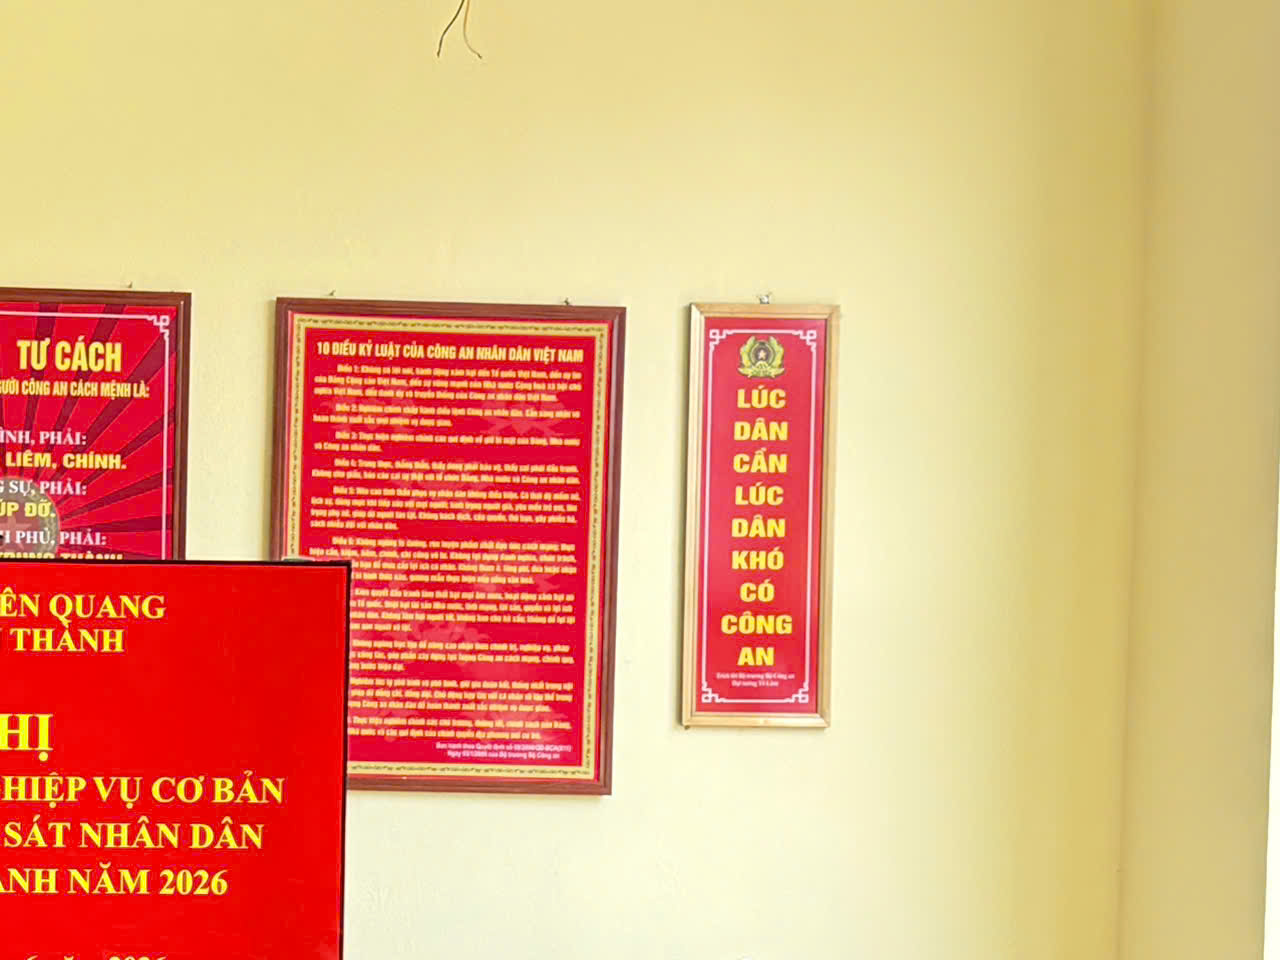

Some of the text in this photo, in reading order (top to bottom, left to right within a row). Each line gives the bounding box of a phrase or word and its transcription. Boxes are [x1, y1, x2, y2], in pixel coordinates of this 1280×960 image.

[16, 338, 121, 371] TƯ CÁCH
[317, 341, 330, 354] 10
[402, 342, 424, 358] CỦA
[426, 343, 456, 359] CÔNG
[458, 346, 474, 359] AN
[508, 346, 531, 361] DÂN
[533, 347, 556, 364] VIỆT
[558, 349, 583, 362] NAM
[21, 379, 50, 395] CÔNG
[52, 381, 67, 395] AN
[70, 381, 98, 396] CÁCH
[737, 385, 786, 409] LÚC
[40, 428, 87, 445] PHẢI:
[733, 417, 788, 441] DÂN
[6, 450, 56, 469] LIÊM,
[62, 452, 126, 469] CHÍNH.
[9, 480, 35, 496] SỰ,
[40, 479, 87, 496] PHẢI:
[735, 481, 784, 506] LÚC
[60, 527, 107, 546] PHẢI:
[731, 514, 786, 538] DÂN
[732, 547, 784, 570] KHÓ
[740, 579, 774, 603] CÓ
[49, 594, 164, 621] QUANG
[721, 610, 792, 635] CÔNG
[10, 623, 123, 651] THÀNH
[737, 647, 774, 666] AN
[93, 776, 141, 807] VỤ
[152, 776, 204, 802] CƠ
[212, 770, 283, 802] BẢN
[4, 814, 70, 847] SÁT
[80, 816, 180, 848] NHÂN
[189, 816, 263, 848] DÂN
[68, 862, 149, 893] NĂM
[159, 869, 227, 894] 2026
